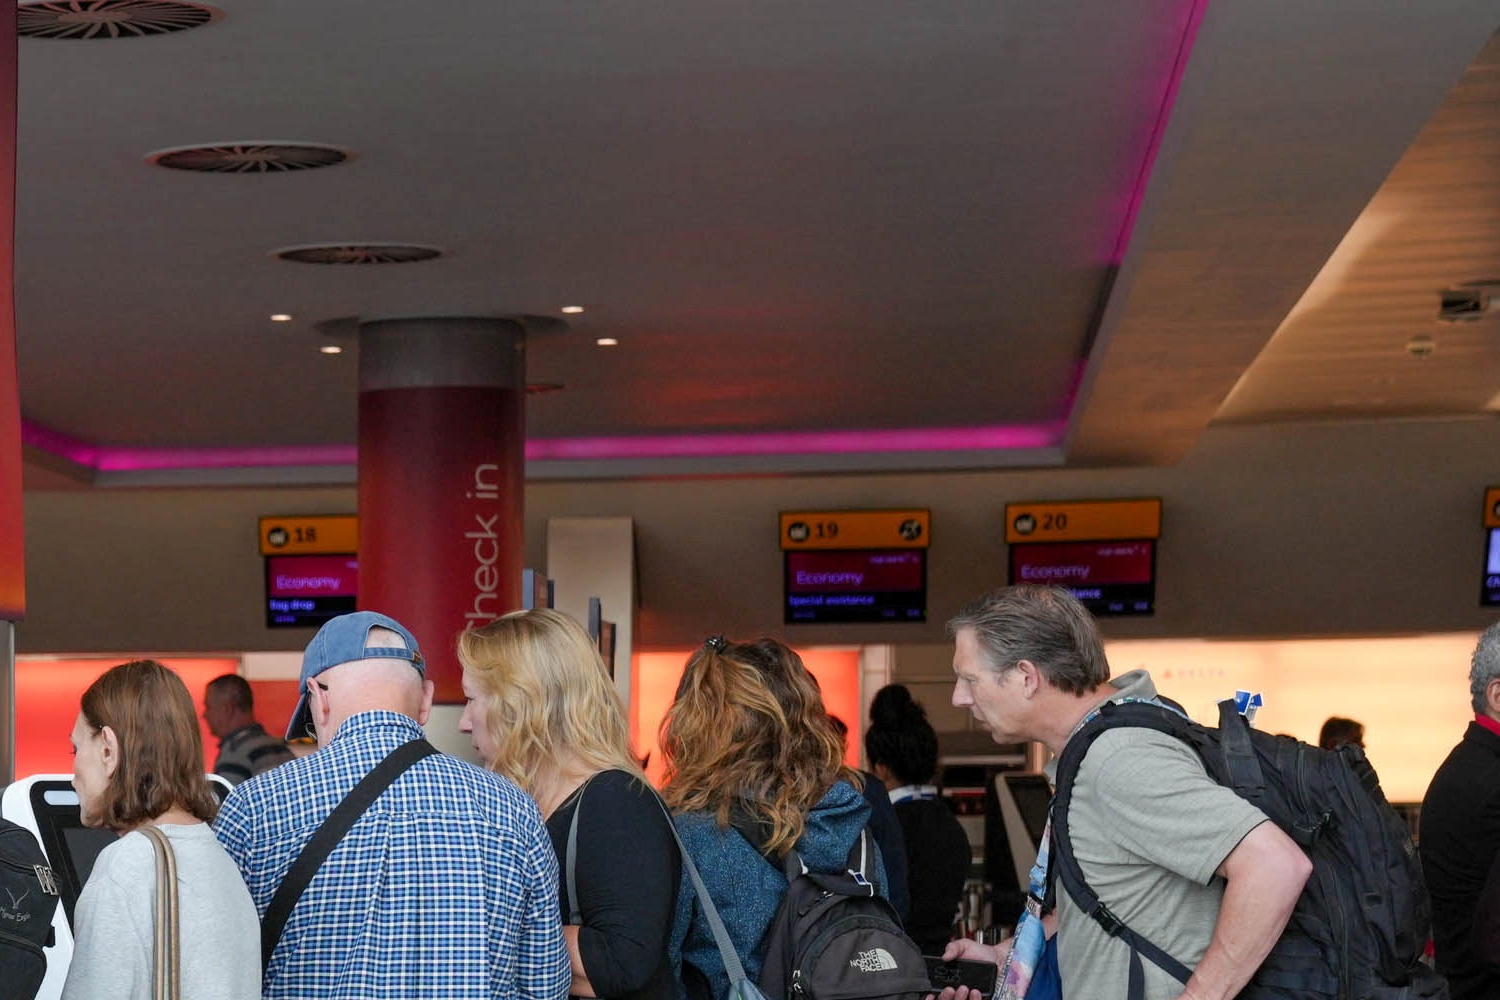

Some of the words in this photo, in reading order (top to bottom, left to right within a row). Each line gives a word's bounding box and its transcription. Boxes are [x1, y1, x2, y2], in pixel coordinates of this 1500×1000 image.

[465, 463, 500, 499] in
[817, 522, 839, 538] 19
[1043, 514, 1067, 530] 20
[295, 527, 317, 542] 18
[464, 514, 500, 633] heck
[796, 570, 864, 586] Economy
[1021, 564, 1090, 580] Economy
[276, 575, 340, 590] Economy
[850, 957, 880, 967] NORTH
[859, 949, 877, 961] THE
[860, 963, 883, 973] FACE
